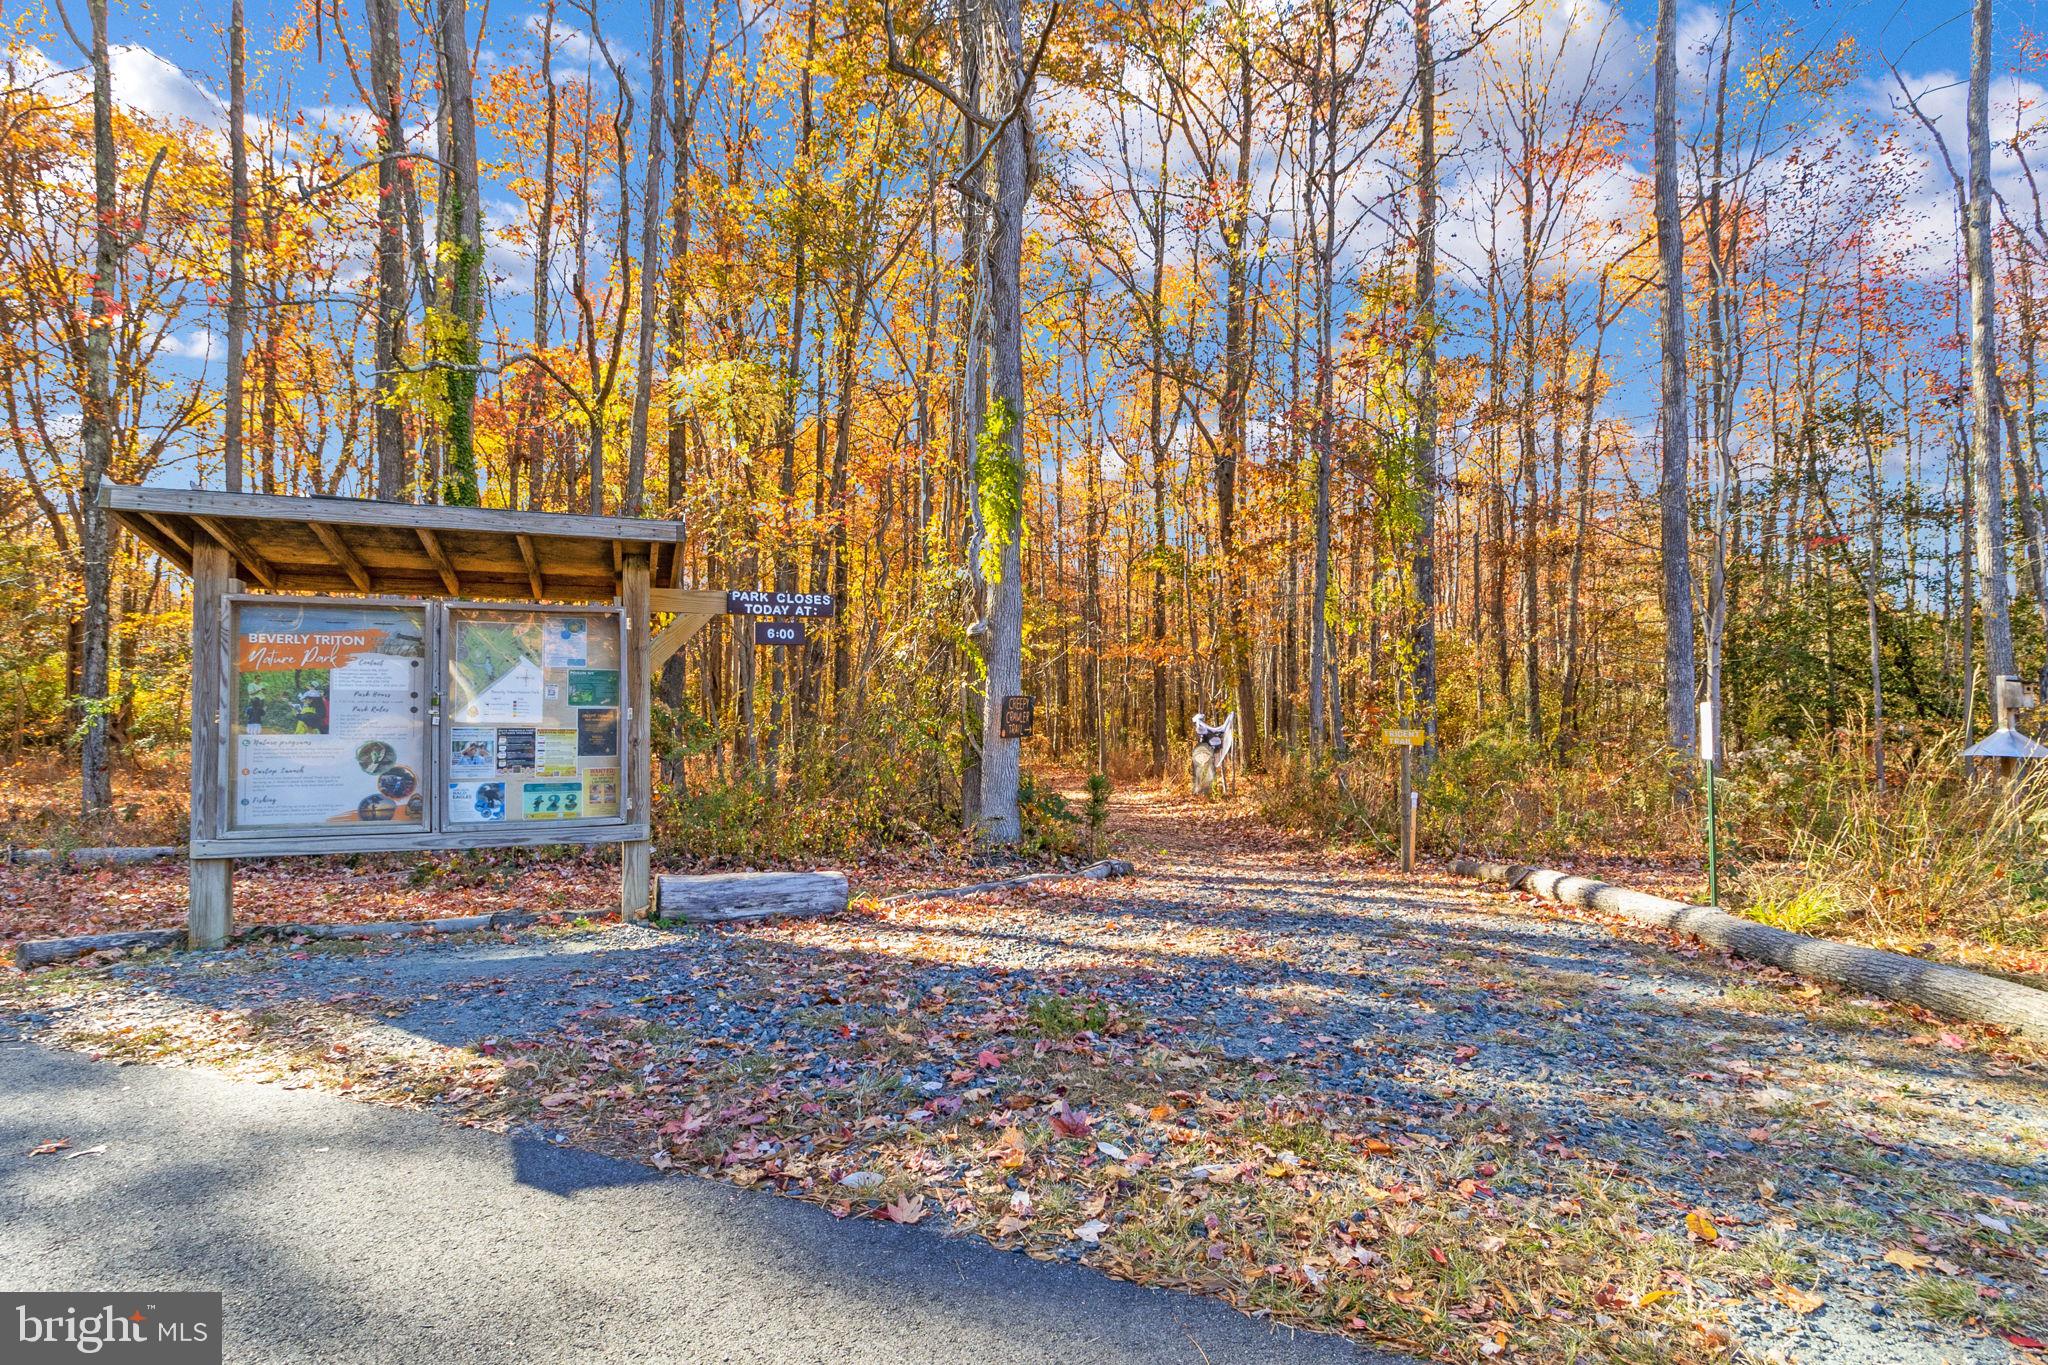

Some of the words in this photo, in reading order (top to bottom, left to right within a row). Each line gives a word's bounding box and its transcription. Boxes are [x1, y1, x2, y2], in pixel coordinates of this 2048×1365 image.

[732, 591, 769, 602] PARK
[776, 593, 831, 606] CLOSES
[744, 604, 790, 615] TODAY
[795, 606, 818, 616] AT:
[248, 633, 310, 645] BEVERLY
[313, 635, 365, 646] TRITON
[767, 628, 795, 639] 6:00
[248, 647, 296, 670] Nature
[300, 640, 340, 668] Park
[1008, 697, 1030, 710] CREEPY
[546, 794, 560, 811] 2
[564, 794, 578, 811] 3
